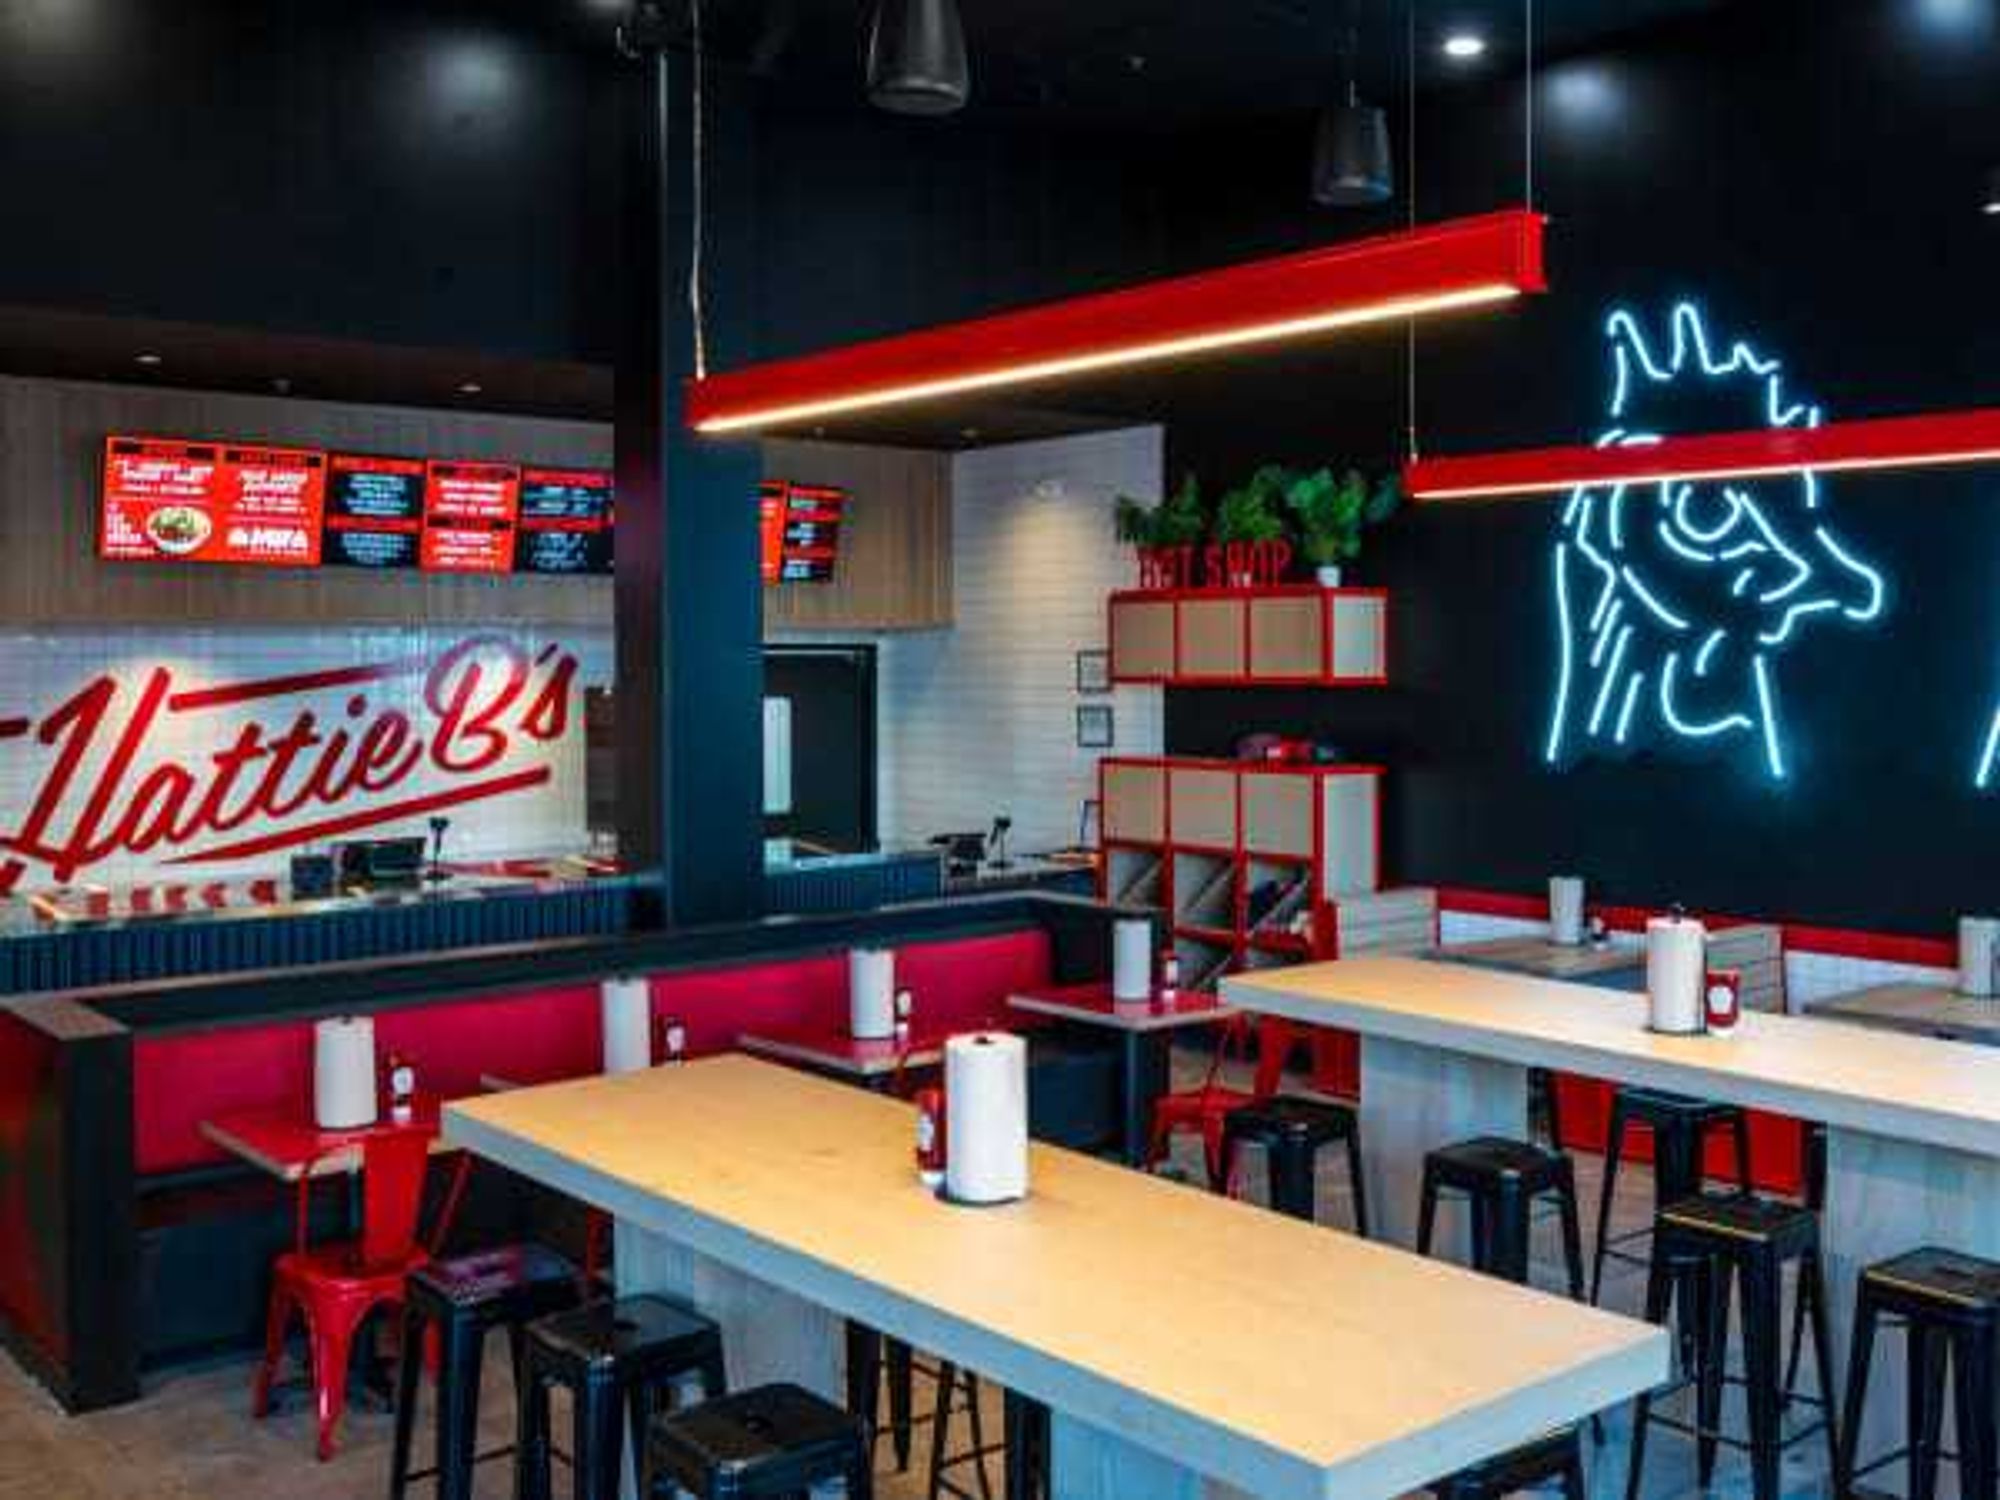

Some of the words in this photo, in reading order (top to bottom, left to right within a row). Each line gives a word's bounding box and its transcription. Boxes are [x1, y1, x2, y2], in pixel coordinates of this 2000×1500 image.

[1204, 537, 1292, 588] SHOP
[0, 667, 424, 882] Hattie
[424, 633, 579, 773] B's
